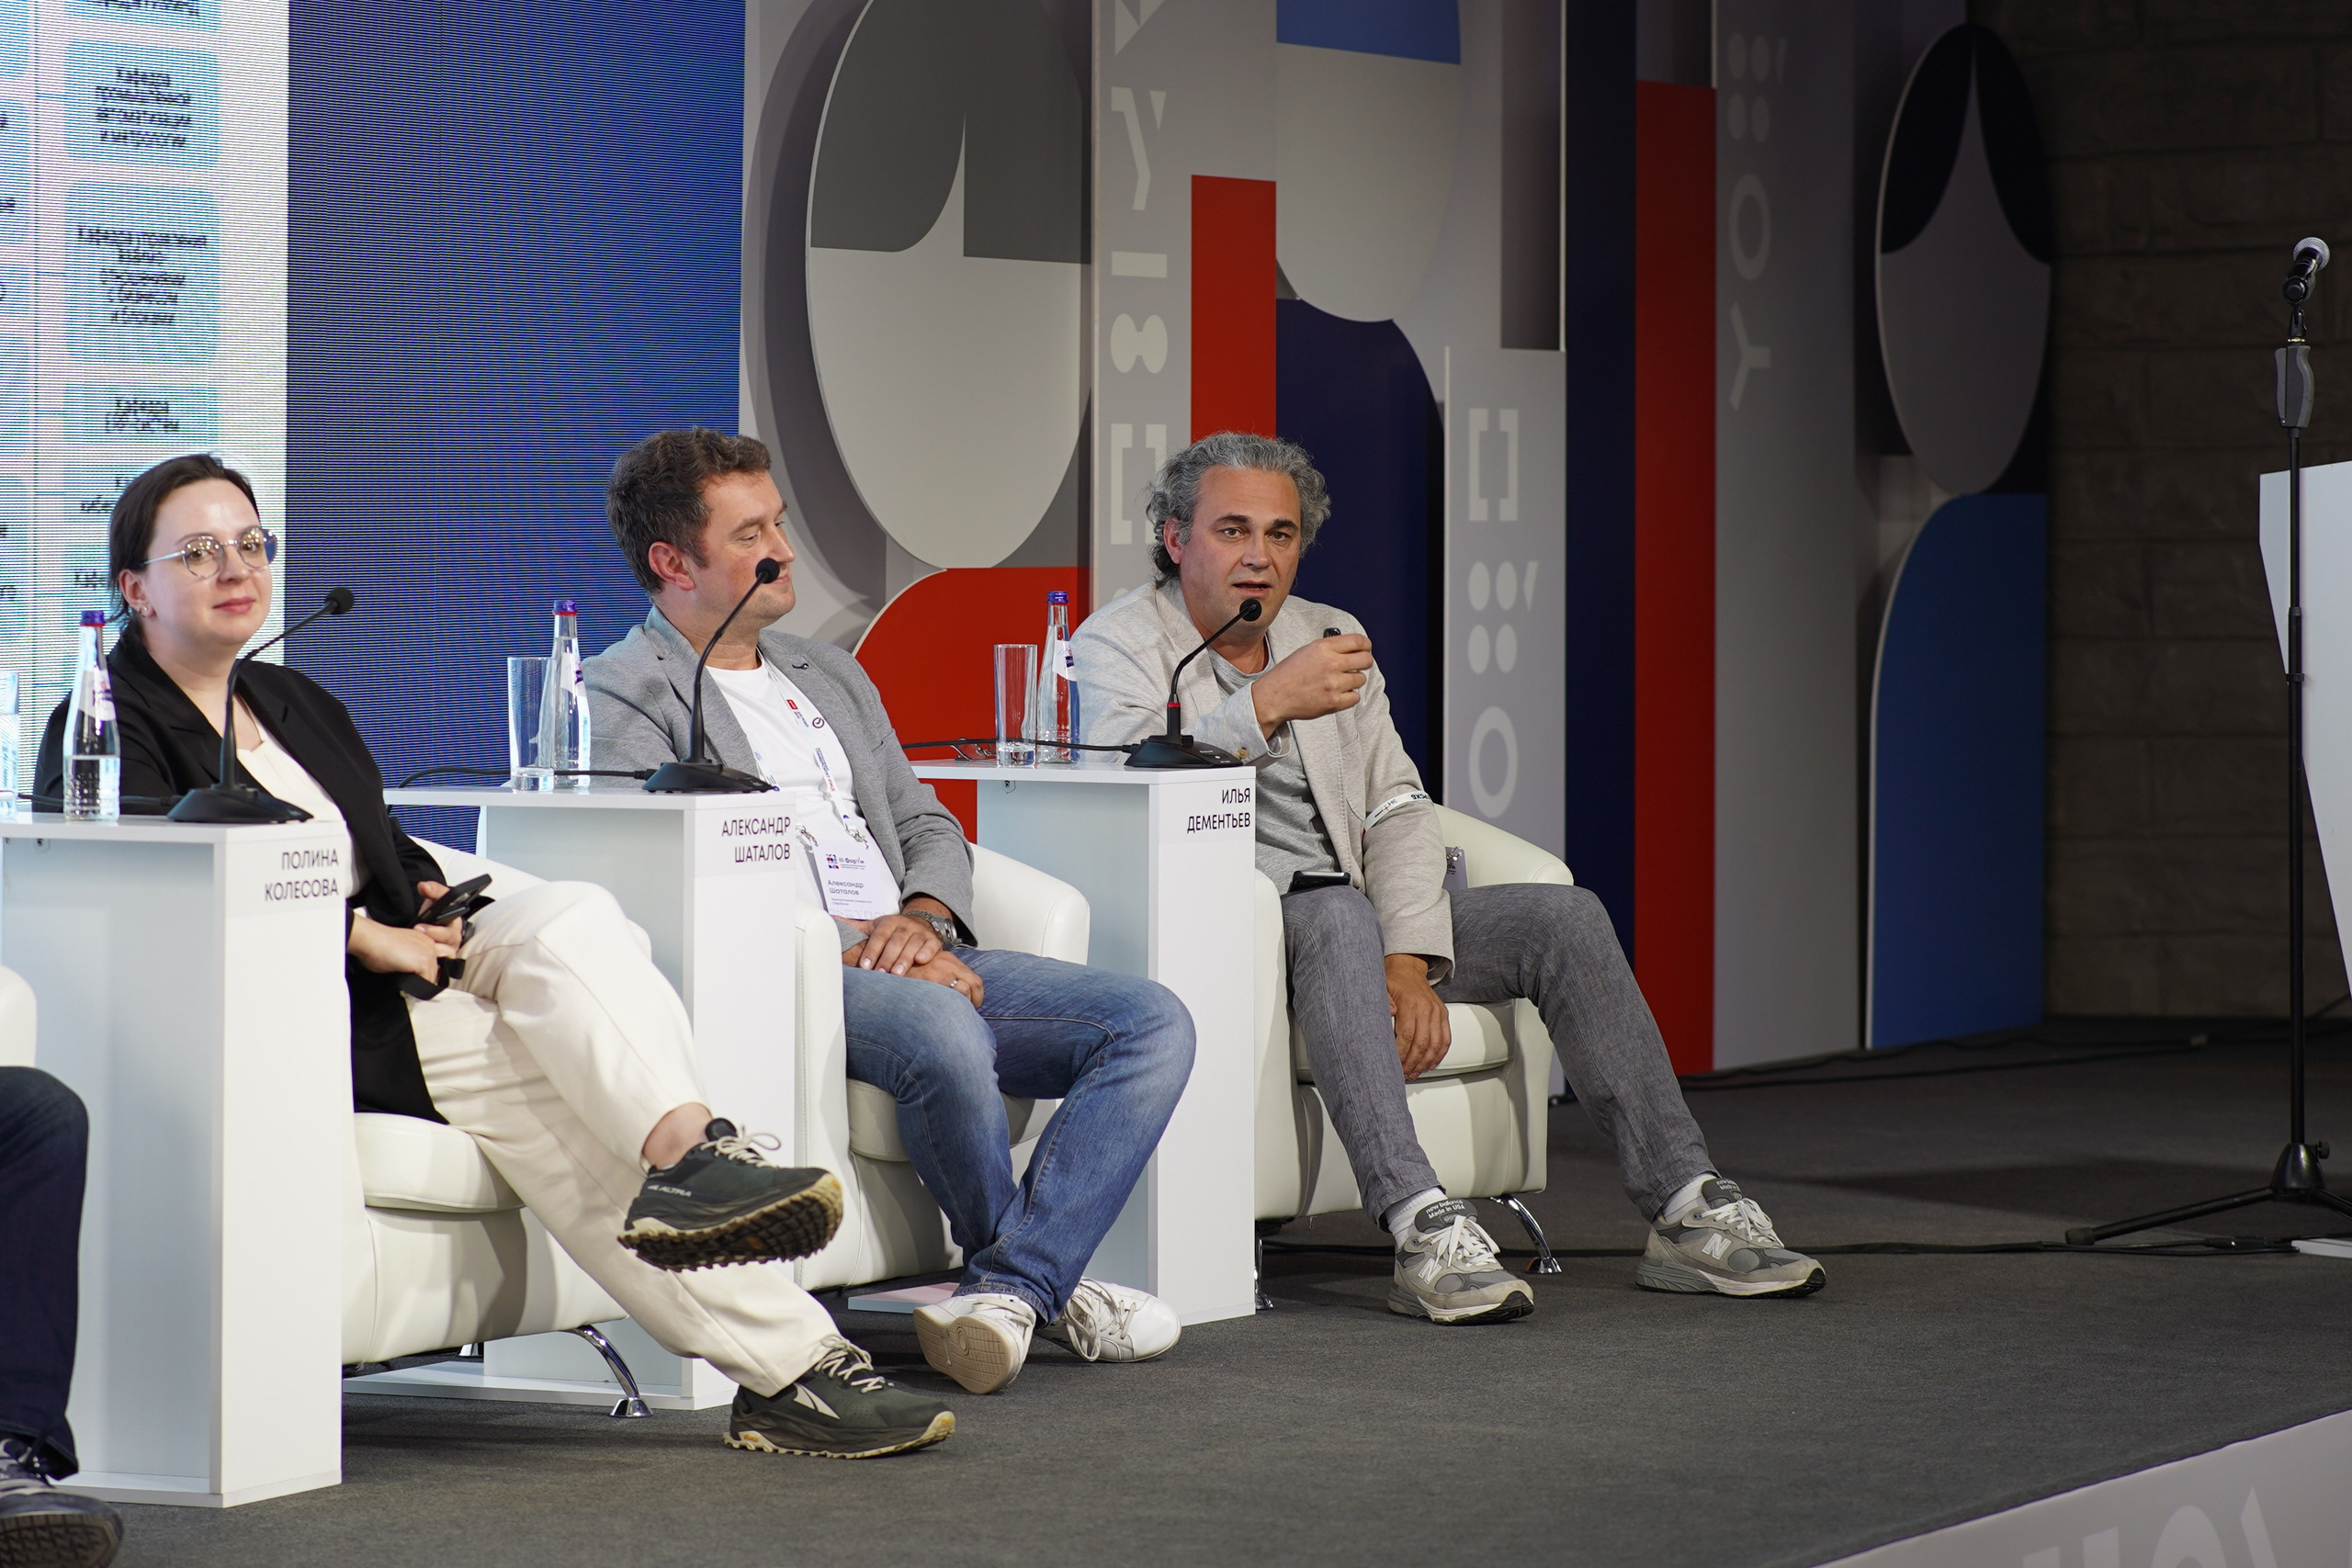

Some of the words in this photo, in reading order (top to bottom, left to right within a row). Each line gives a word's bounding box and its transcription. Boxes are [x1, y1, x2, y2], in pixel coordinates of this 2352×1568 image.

[116, 66, 171, 87] Кафедра
[96, 107, 191, 128] автоматизации
[111, 130, 186, 149] метрологии
[78, 225, 132, 246] Кафедра
[116, 398, 169, 416] Кафедра
[1221, 787, 1250, 804] ИЛЬЯ
[721, 817, 791, 837] АЛЕКСАНДР
[1187, 812, 1250, 834] ДЕМЕНТЬЕВ
[281, 849, 339, 870] ПОЛИНА
[735, 843, 791, 863] ШАТАЛОВ
[265, 878, 338, 901] КОЛЕСОВА
[828, 879, 865, 888] Александр
[829, 887, 860, 896] Шаталов
[1426, 1204, 1440, 1214] new
[1428, 1209, 1446, 1219] Made
[1702, 1232, 1733, 1260] N
[1418, 1258, 1443, 1285] N
